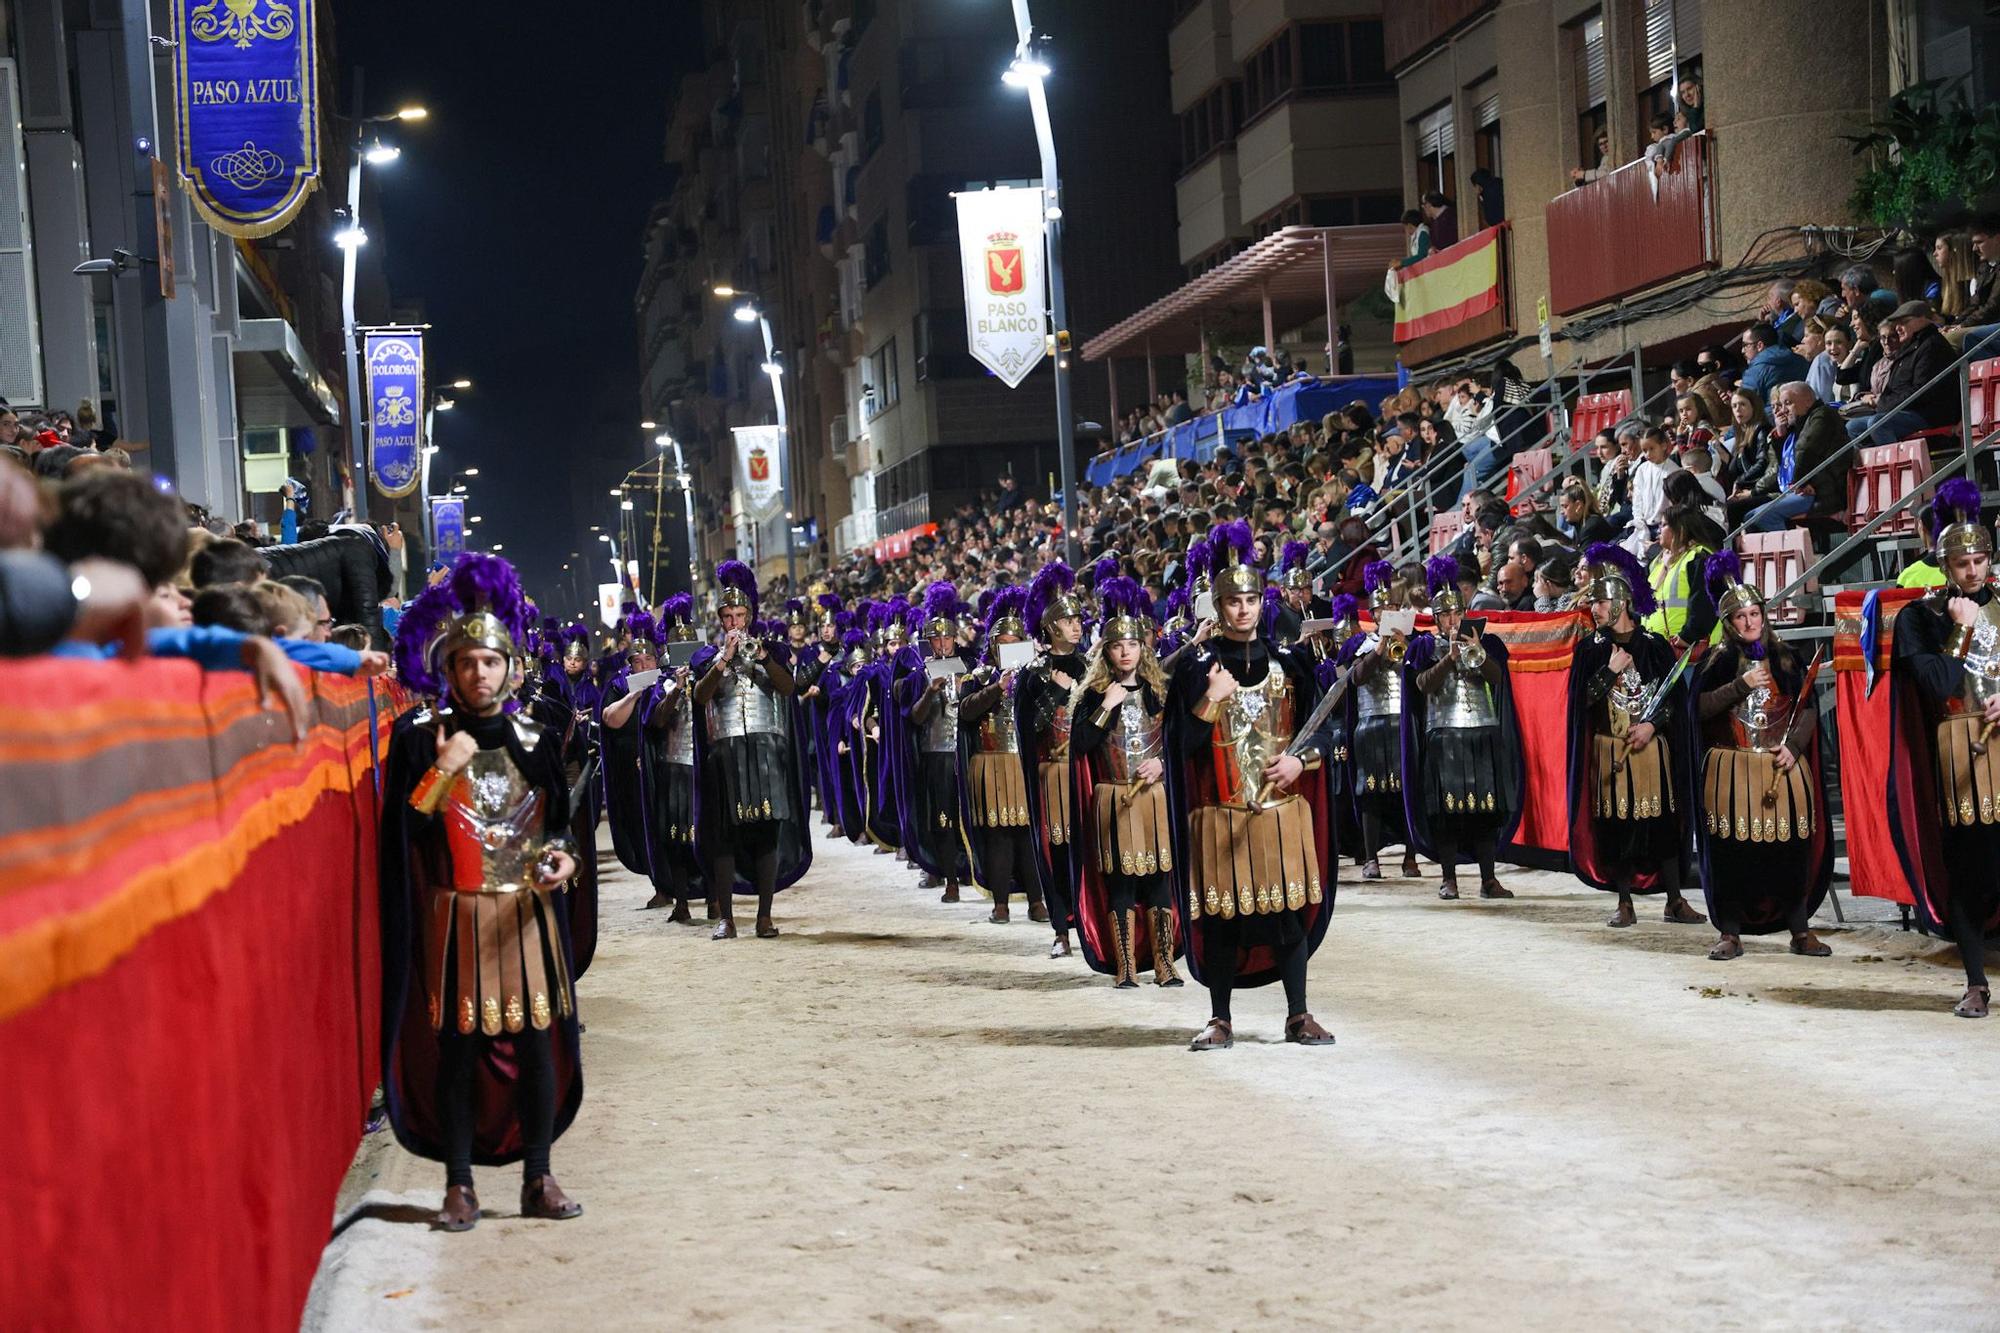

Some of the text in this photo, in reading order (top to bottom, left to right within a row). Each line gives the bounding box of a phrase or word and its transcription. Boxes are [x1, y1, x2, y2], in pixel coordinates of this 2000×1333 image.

[192, 79, 299, 104] PASO AZUL
[987, 302, 1026, 316] PASO
[977, 318, 1038, 333] BLANCO
[373, 364, 416, 376] DOLOROSA
[375, 435, 416, 447] PASO AZUL
